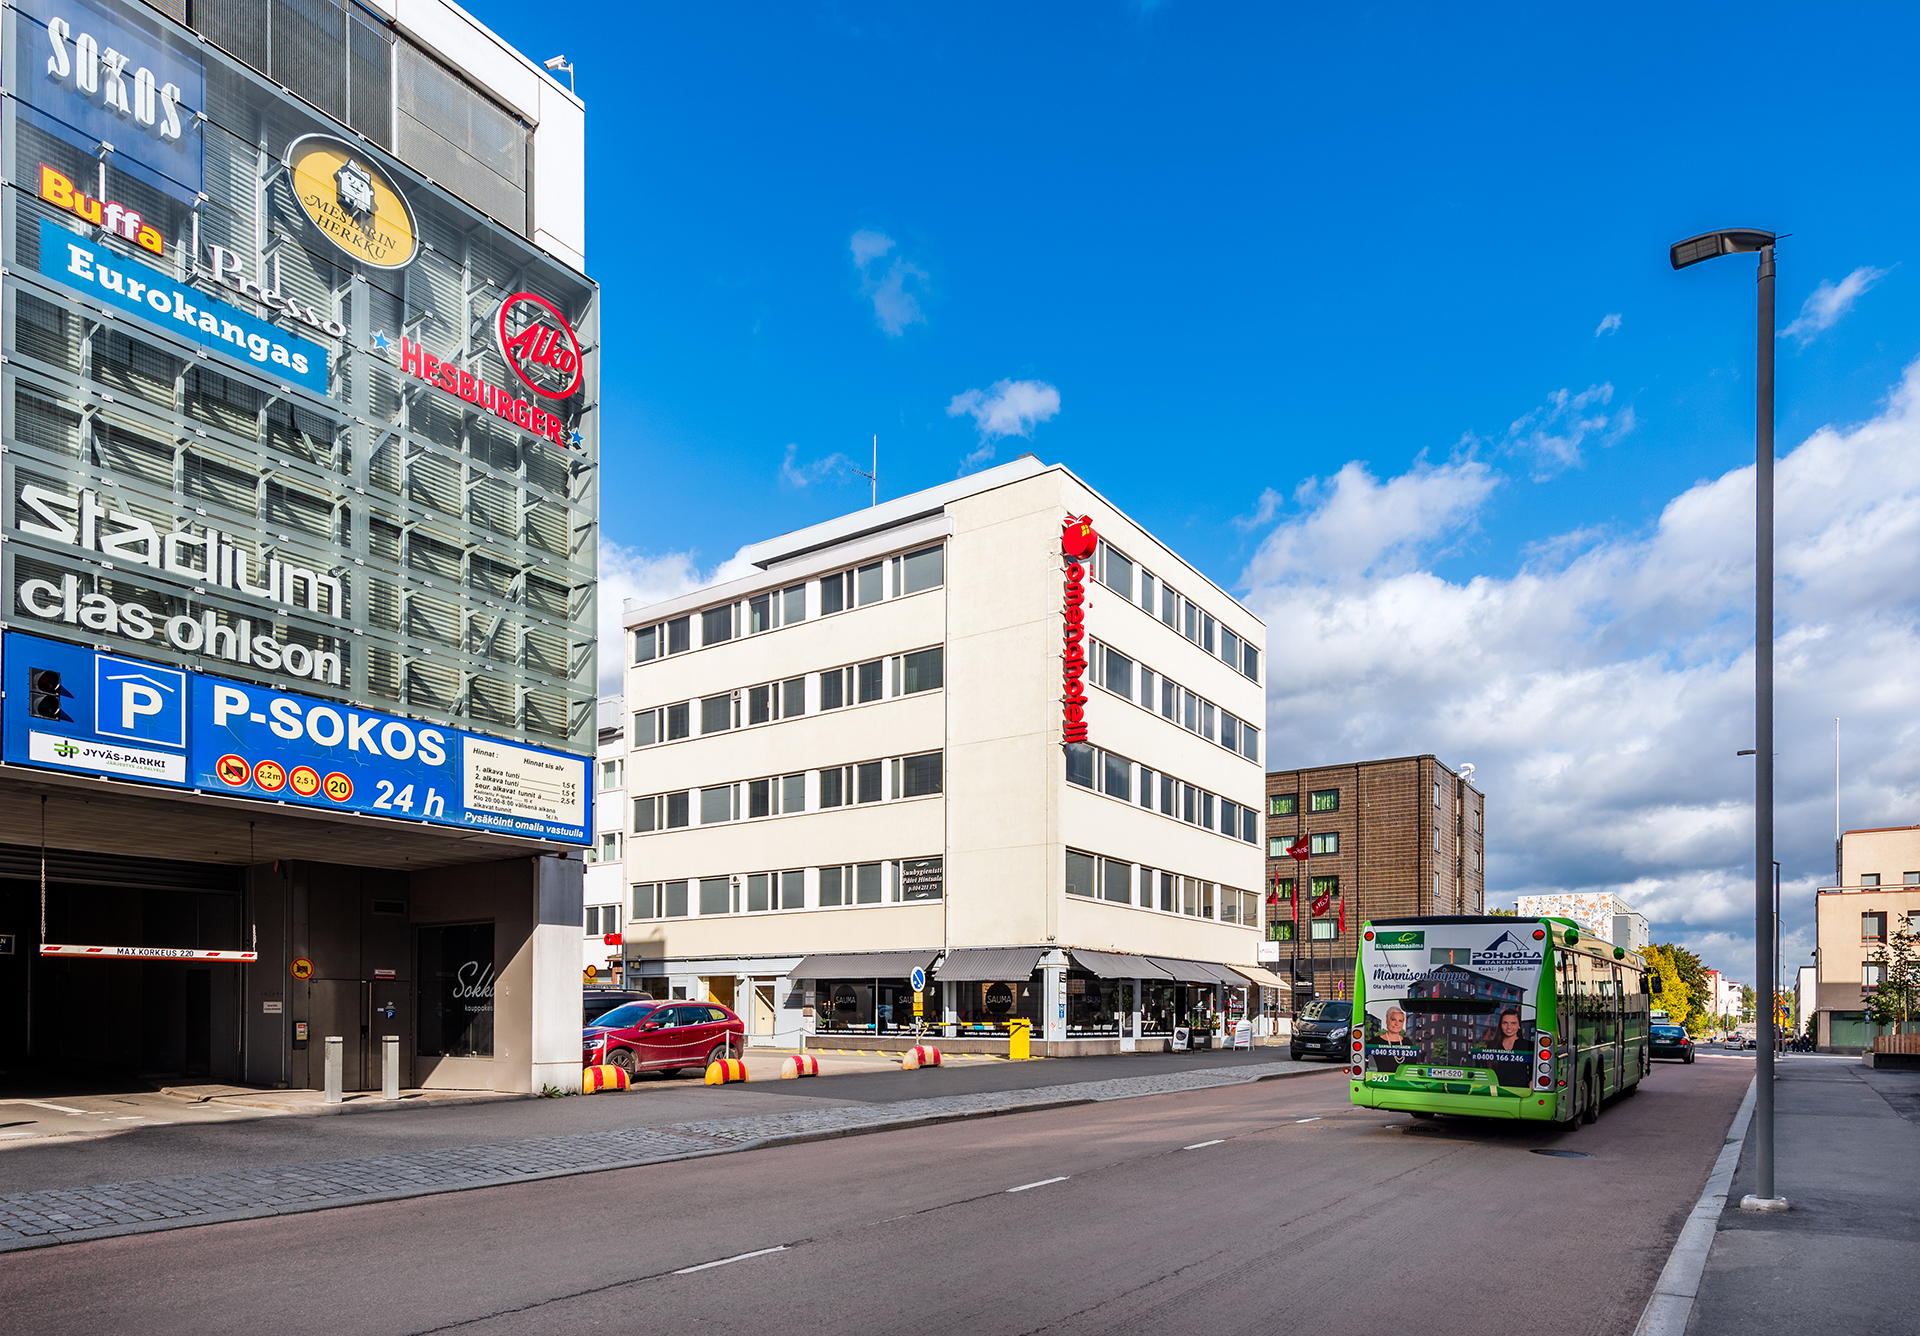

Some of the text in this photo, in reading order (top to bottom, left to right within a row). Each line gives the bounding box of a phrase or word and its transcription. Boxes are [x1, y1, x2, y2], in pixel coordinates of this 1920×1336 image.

[47, 16, 181, 140] SOKOS
[41, 165, 164, 256] Buffa
[304, 195, 396, 249] MESTARIN
[317, 215, 386, 260] HERKKU
[209, 243, 347, 339] Presso
[67, 243, 309, 375] Eurokangas
[508, 323, 577, 374] Alko
[401, 337, 564, 448] HESBURGER
[19, 484, 342, 618] stadium
[20, 574, 342, 685] clas ohlson
[1065, 563, 1088, 743] omenahotelli
[123, 682, 162, 729] P
[214, 685, 446, 766] P-SOKOS
[83, 749, 165, 768] JYVÄS-PARKKI
[473, 748, 495, 758] Hinnat
[106, 761, 135, 769] JÄRJESTYS
[483, 766, 503, 776] alkava
[524, 758, 544, 768] Hinnat
[545, 762, 553, 770] sis
[296, 776, 309, 785] 2,5
[330, 781, 346, 794] 20
[483, 775, 503, 785] alkava
[374, 780, 444, 817] 24 h
[492, 785, 515, 794] alkavat
[518, 790, 536, 798] tunnit
[473, 802, 495, 811] alkavat
[515, 802, 537, 811] välisenä
[465, 812, 583, 837] Pysäköinti omalla vastuulla
[1449, 950, 1454, 964] 1
[1373, 968, 1469, 984] Mannisenhuippu
[835, 996, 856, 1004] SAUMA
[987, 995, 1012, 1003] SAUMA
[1372, 1074, 1389, 1082] 520
[1432, 1068, 1462, 1077] KMT-520
